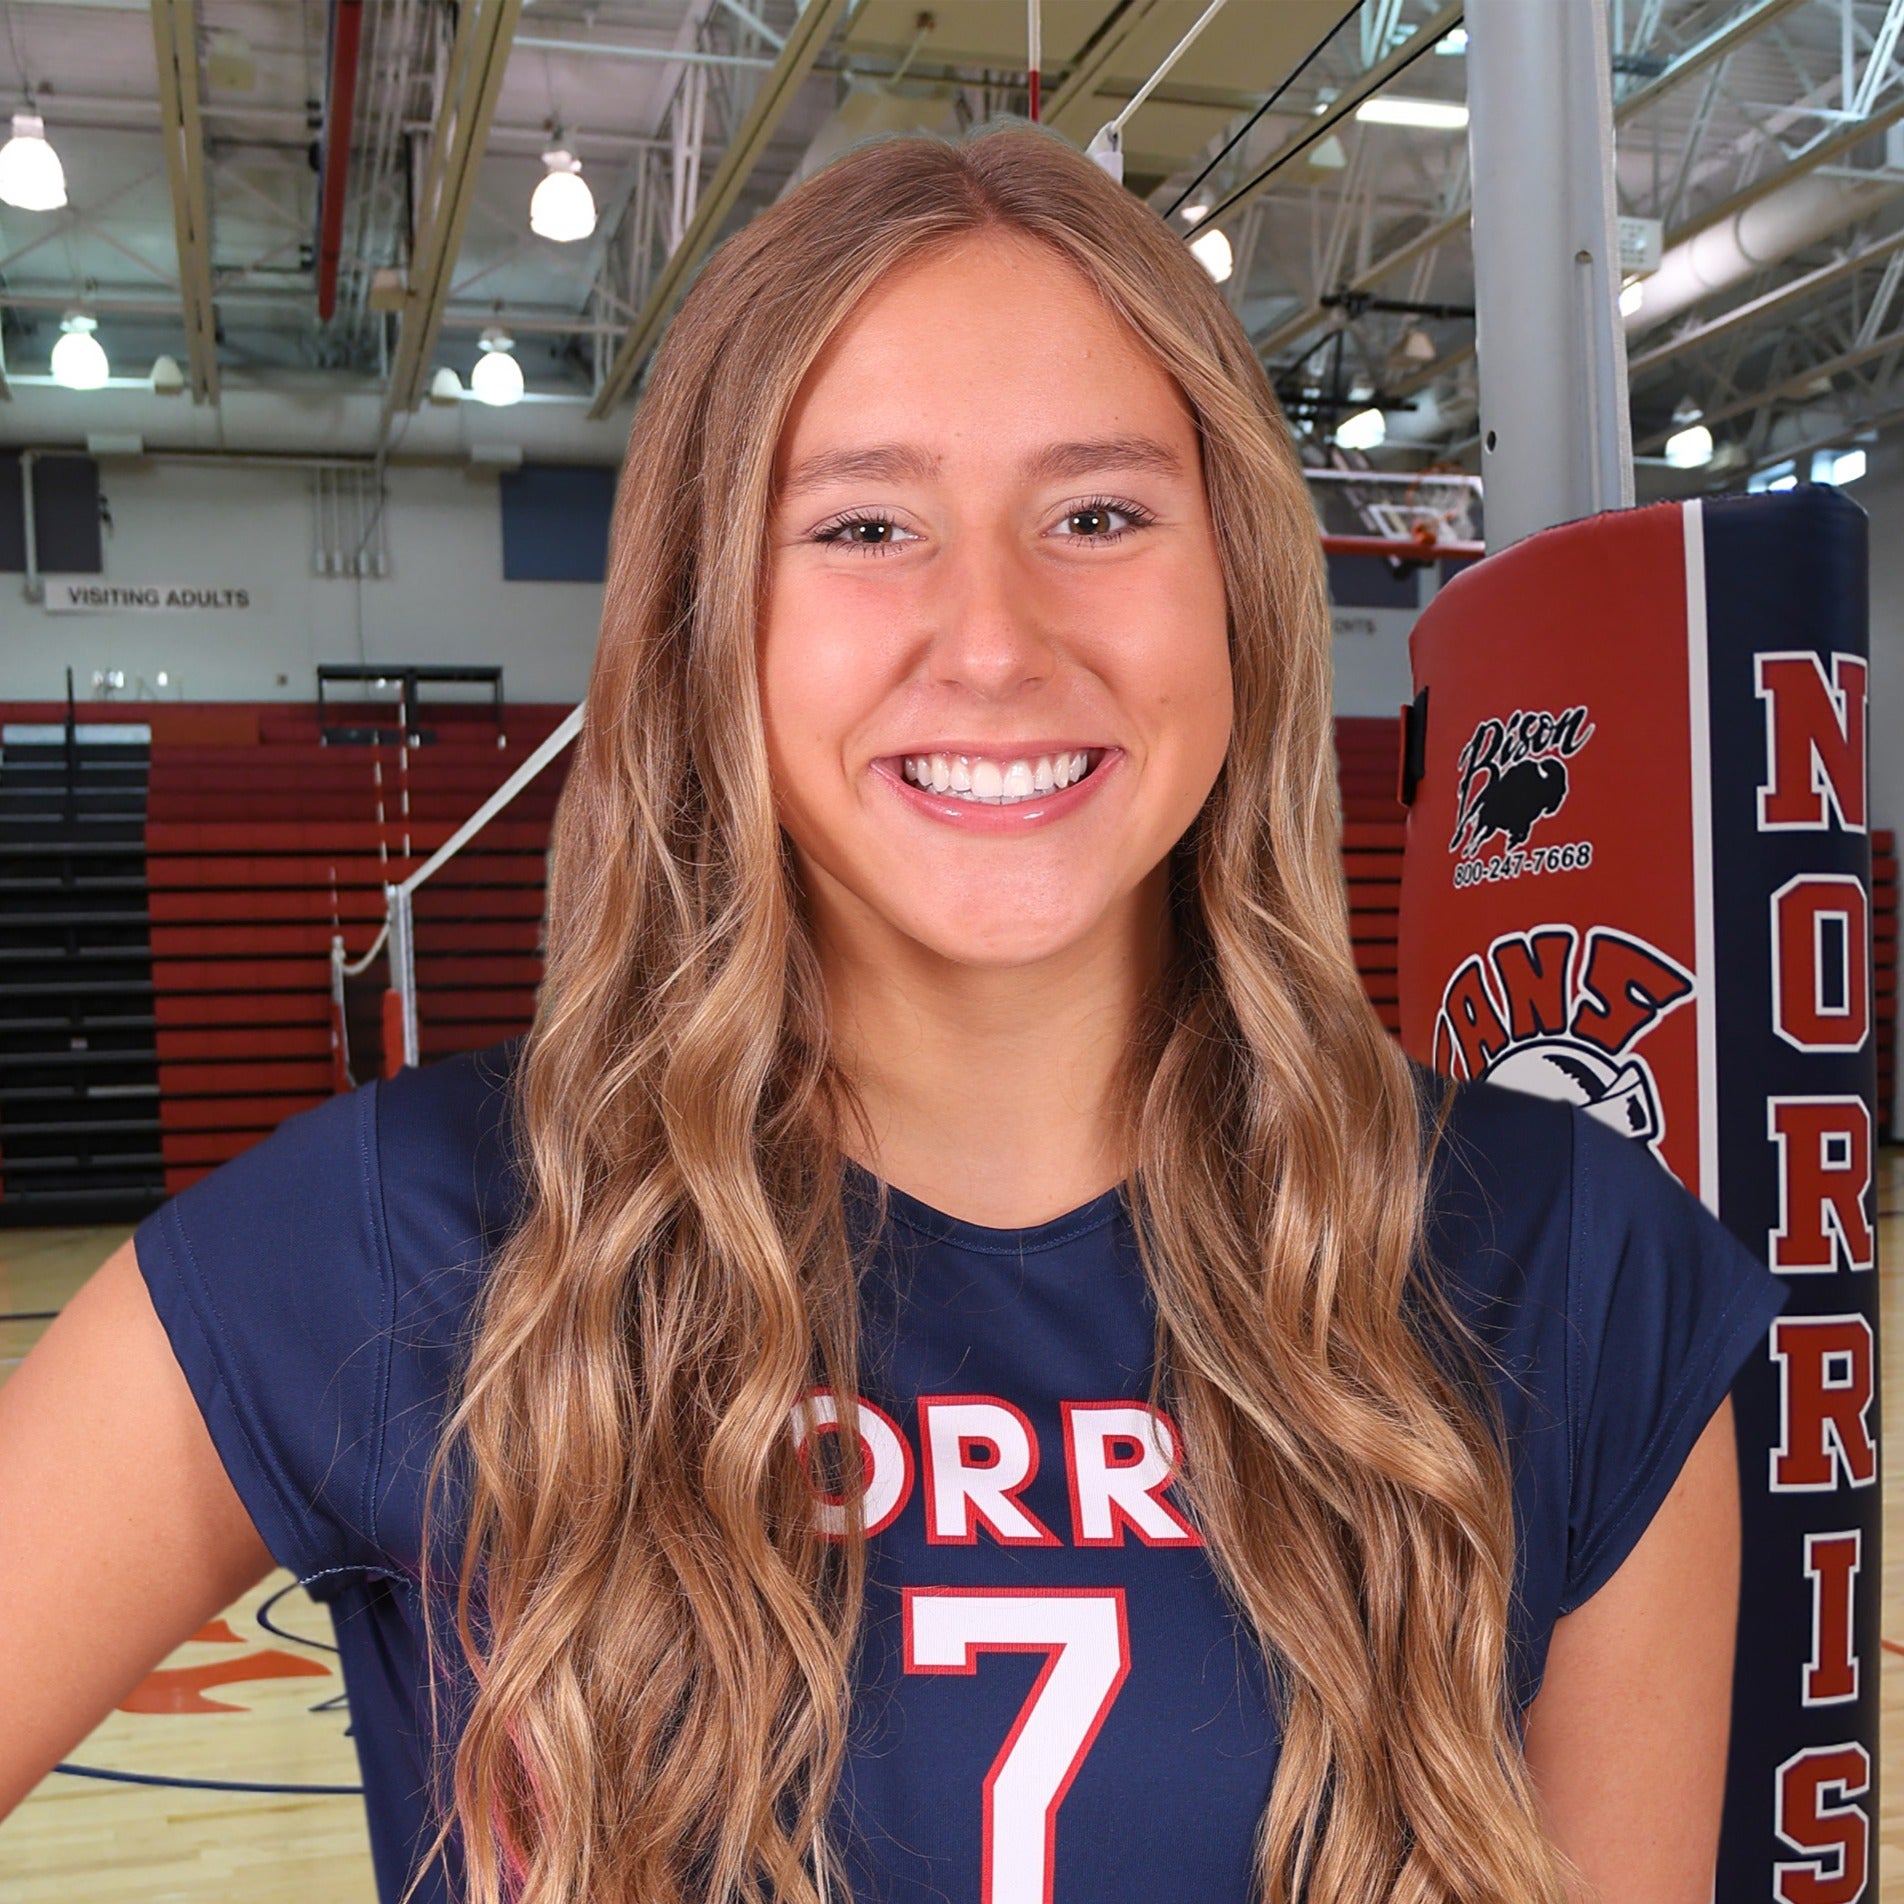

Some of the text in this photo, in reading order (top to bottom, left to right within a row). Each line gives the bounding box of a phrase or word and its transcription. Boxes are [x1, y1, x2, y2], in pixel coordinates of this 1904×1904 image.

[69, 587, 249, 608] VISITING ADULTS
[1454, 706, 1595, 828] Bison
[1454, 843, 1593, 889] 800-247-7668
[1753, 650, 1876, 1904] NORRIS
[902, 1586, 1131, 1904] 7
